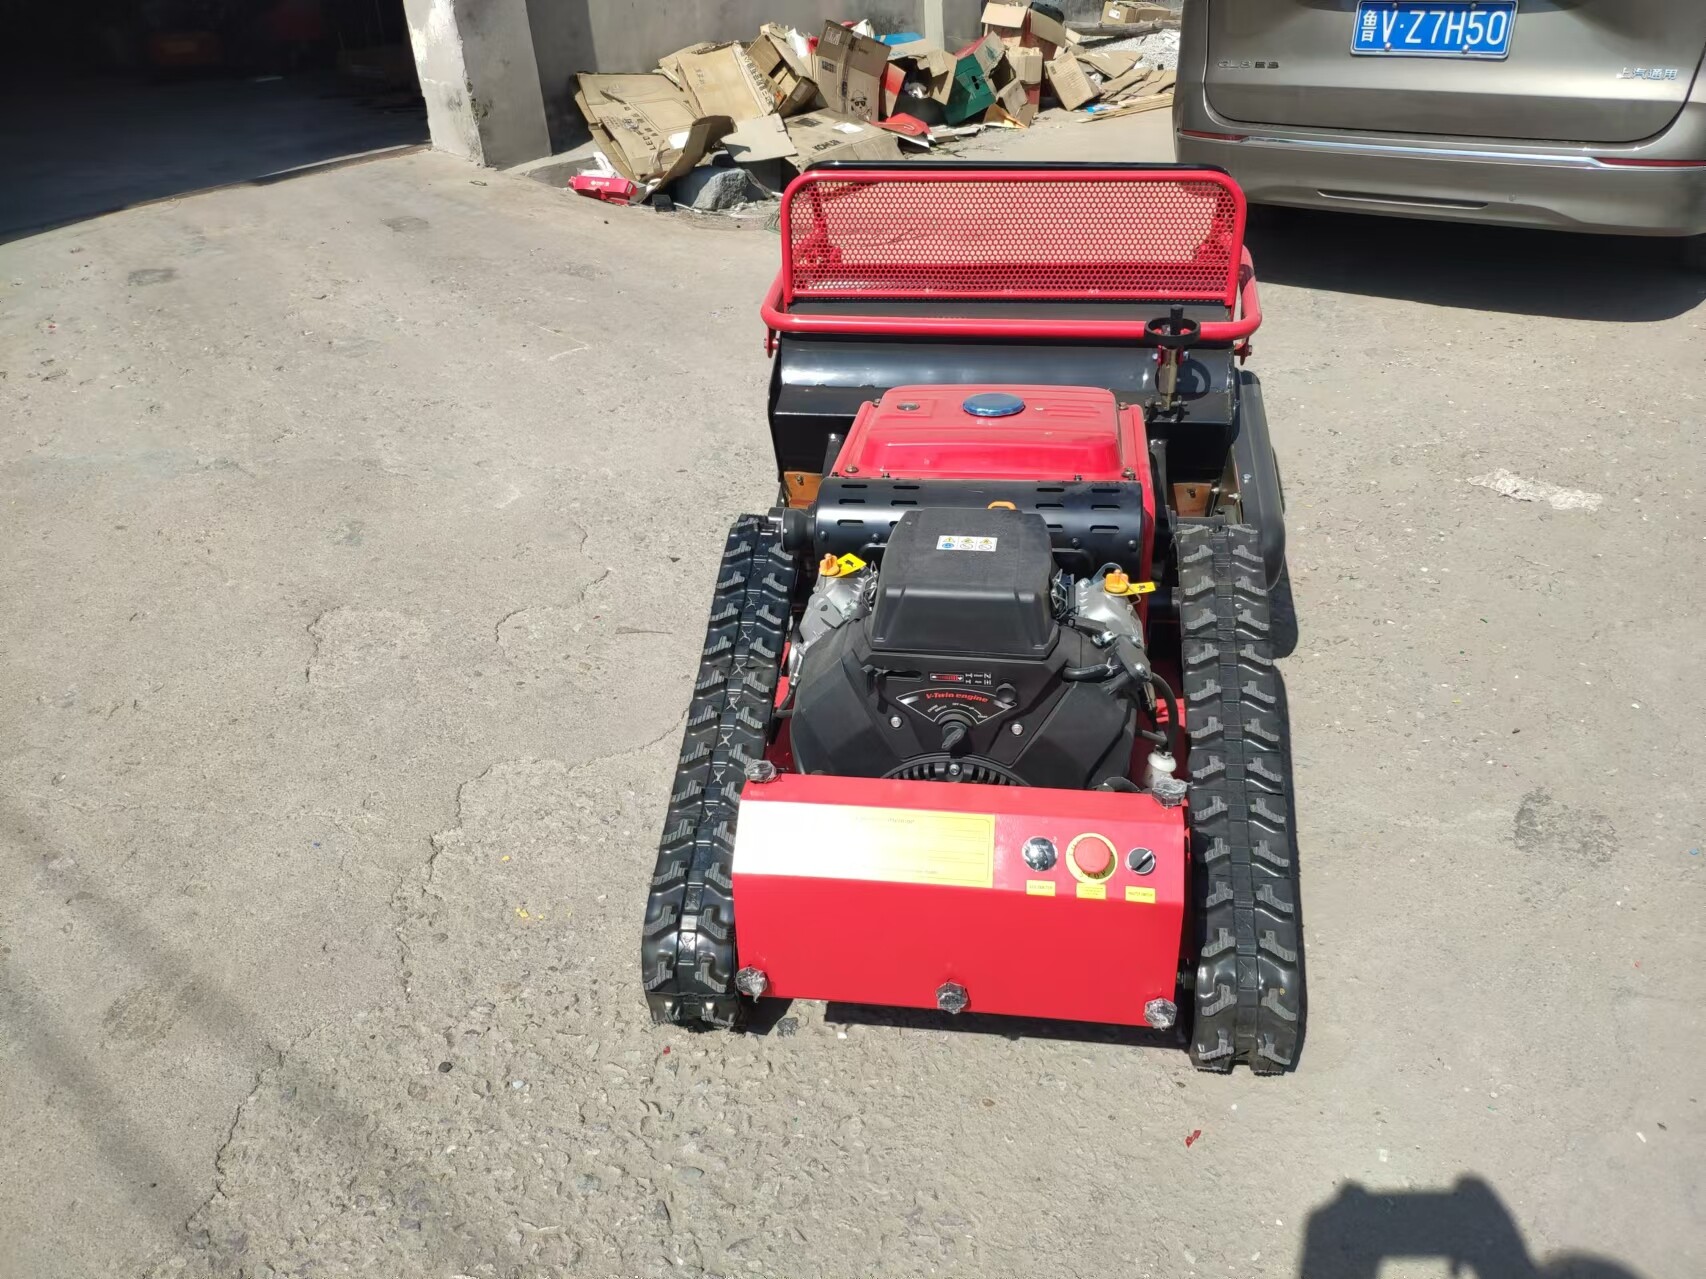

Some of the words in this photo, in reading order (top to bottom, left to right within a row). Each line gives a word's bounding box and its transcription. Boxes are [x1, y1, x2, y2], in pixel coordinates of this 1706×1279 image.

[1616, 67, 1678, 81] 上汽通用
[956, 693, 989, 703] engine
